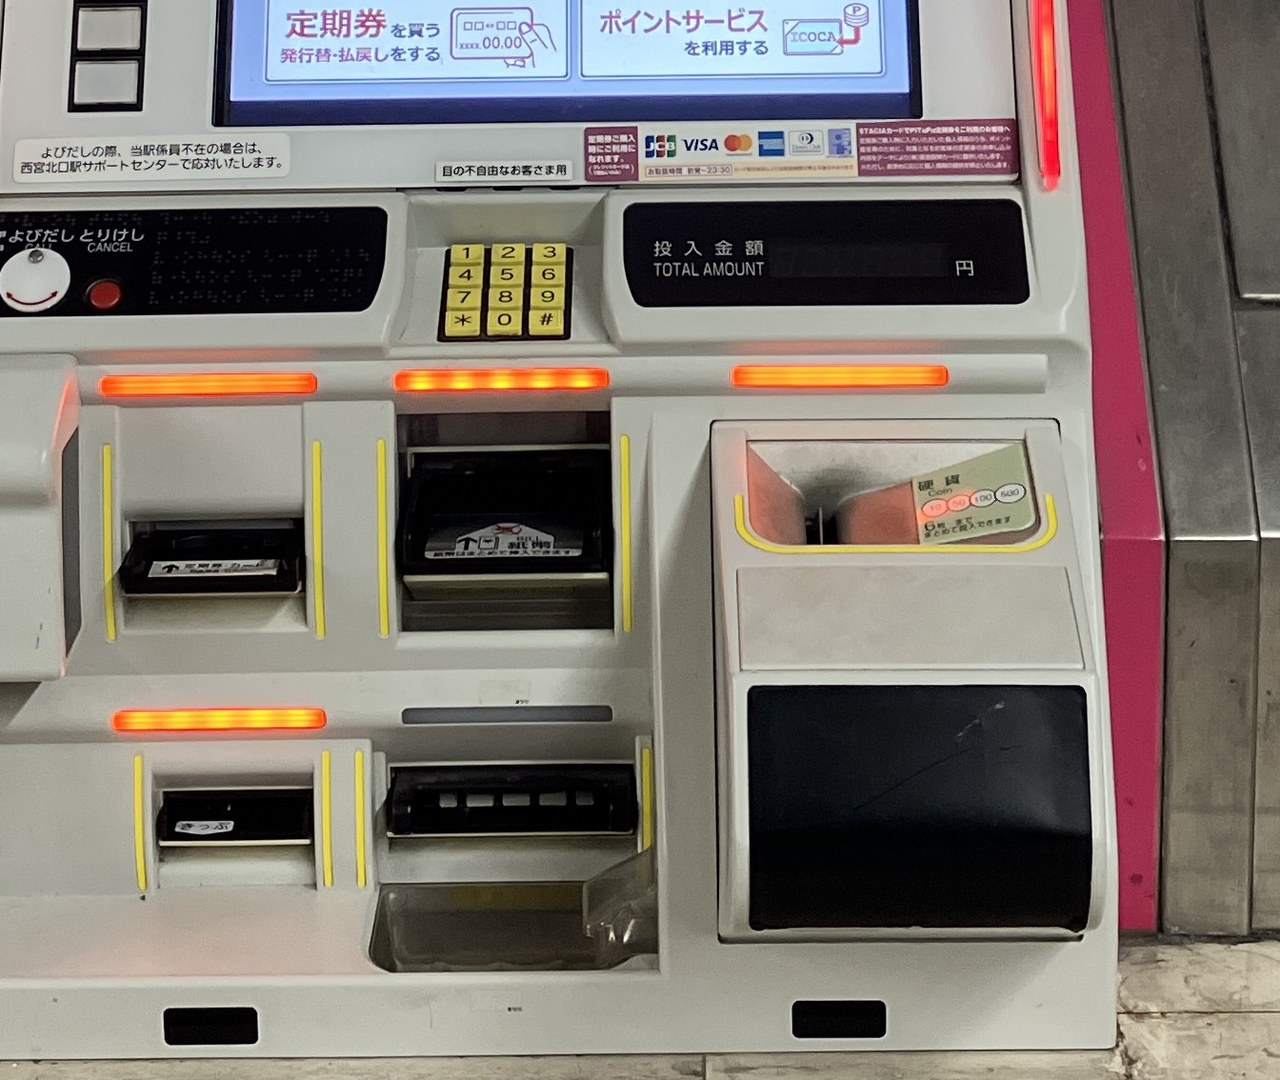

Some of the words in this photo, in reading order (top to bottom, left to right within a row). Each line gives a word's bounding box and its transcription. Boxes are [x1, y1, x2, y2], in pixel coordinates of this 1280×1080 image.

[599, 6, 769, 35] ポイントサービス
[790, 30, 837, 43] ICOCA
[683, 40, 769, 56] を利用する
[680, 137, 719, 152] VISA
[442, 164, 567, 177] 目の不自由なお客さま用
[8, 229, 75, 243] よびだし
[79, 228, 145, 243] とりけし
[87, 242, 133, 252] CANCEL
[462, 247, 470, 259] 1
[501, 246, 516, 259] 2
[543, 246, 557, 258] 3
[653, 239, 764, 257] 投入金額
[500, 268, 514, 281] 5
[541, 268, 556, 281] 6
[653, 261, 699, 277] TOTAL
[703, 261, 765, 276] AMOUNT
[955, 259, 975, 277] 円
[458, 269, 473, 281] 4
[457, 291, 471, 304] 7
[498, 290, 513, 303] 8
[541, 290, 555, 303] 9
[497, 313, 512, 326] 0
